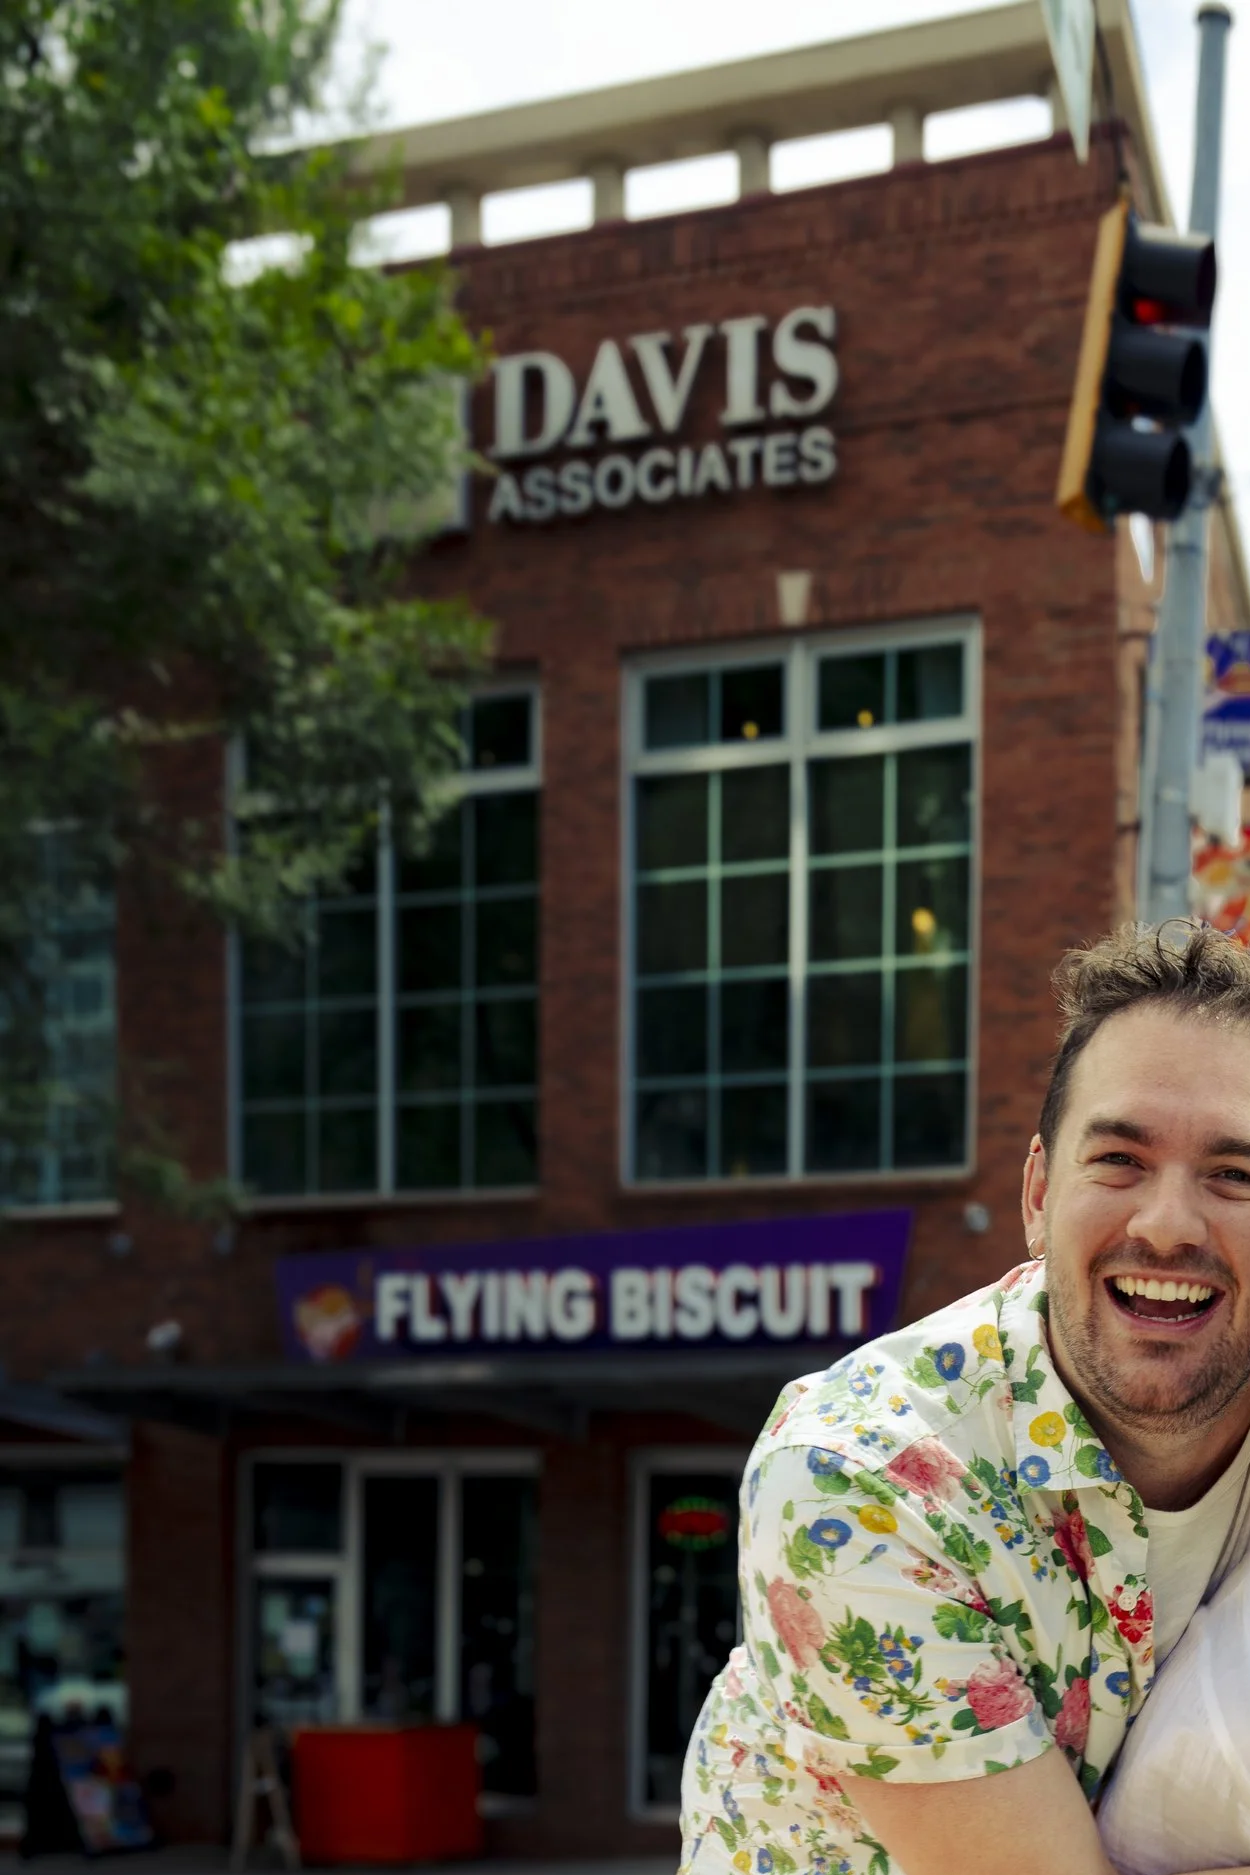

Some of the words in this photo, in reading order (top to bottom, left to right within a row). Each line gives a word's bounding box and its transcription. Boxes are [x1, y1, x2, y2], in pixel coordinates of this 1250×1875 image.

[488, 304, 840, 458] DAVIS
[488, 426, 838, 522] ASSOCIATES
[374, 1266, 598, 1342] FLYING
[610, 1261, 878, 1340] BISCUIT
